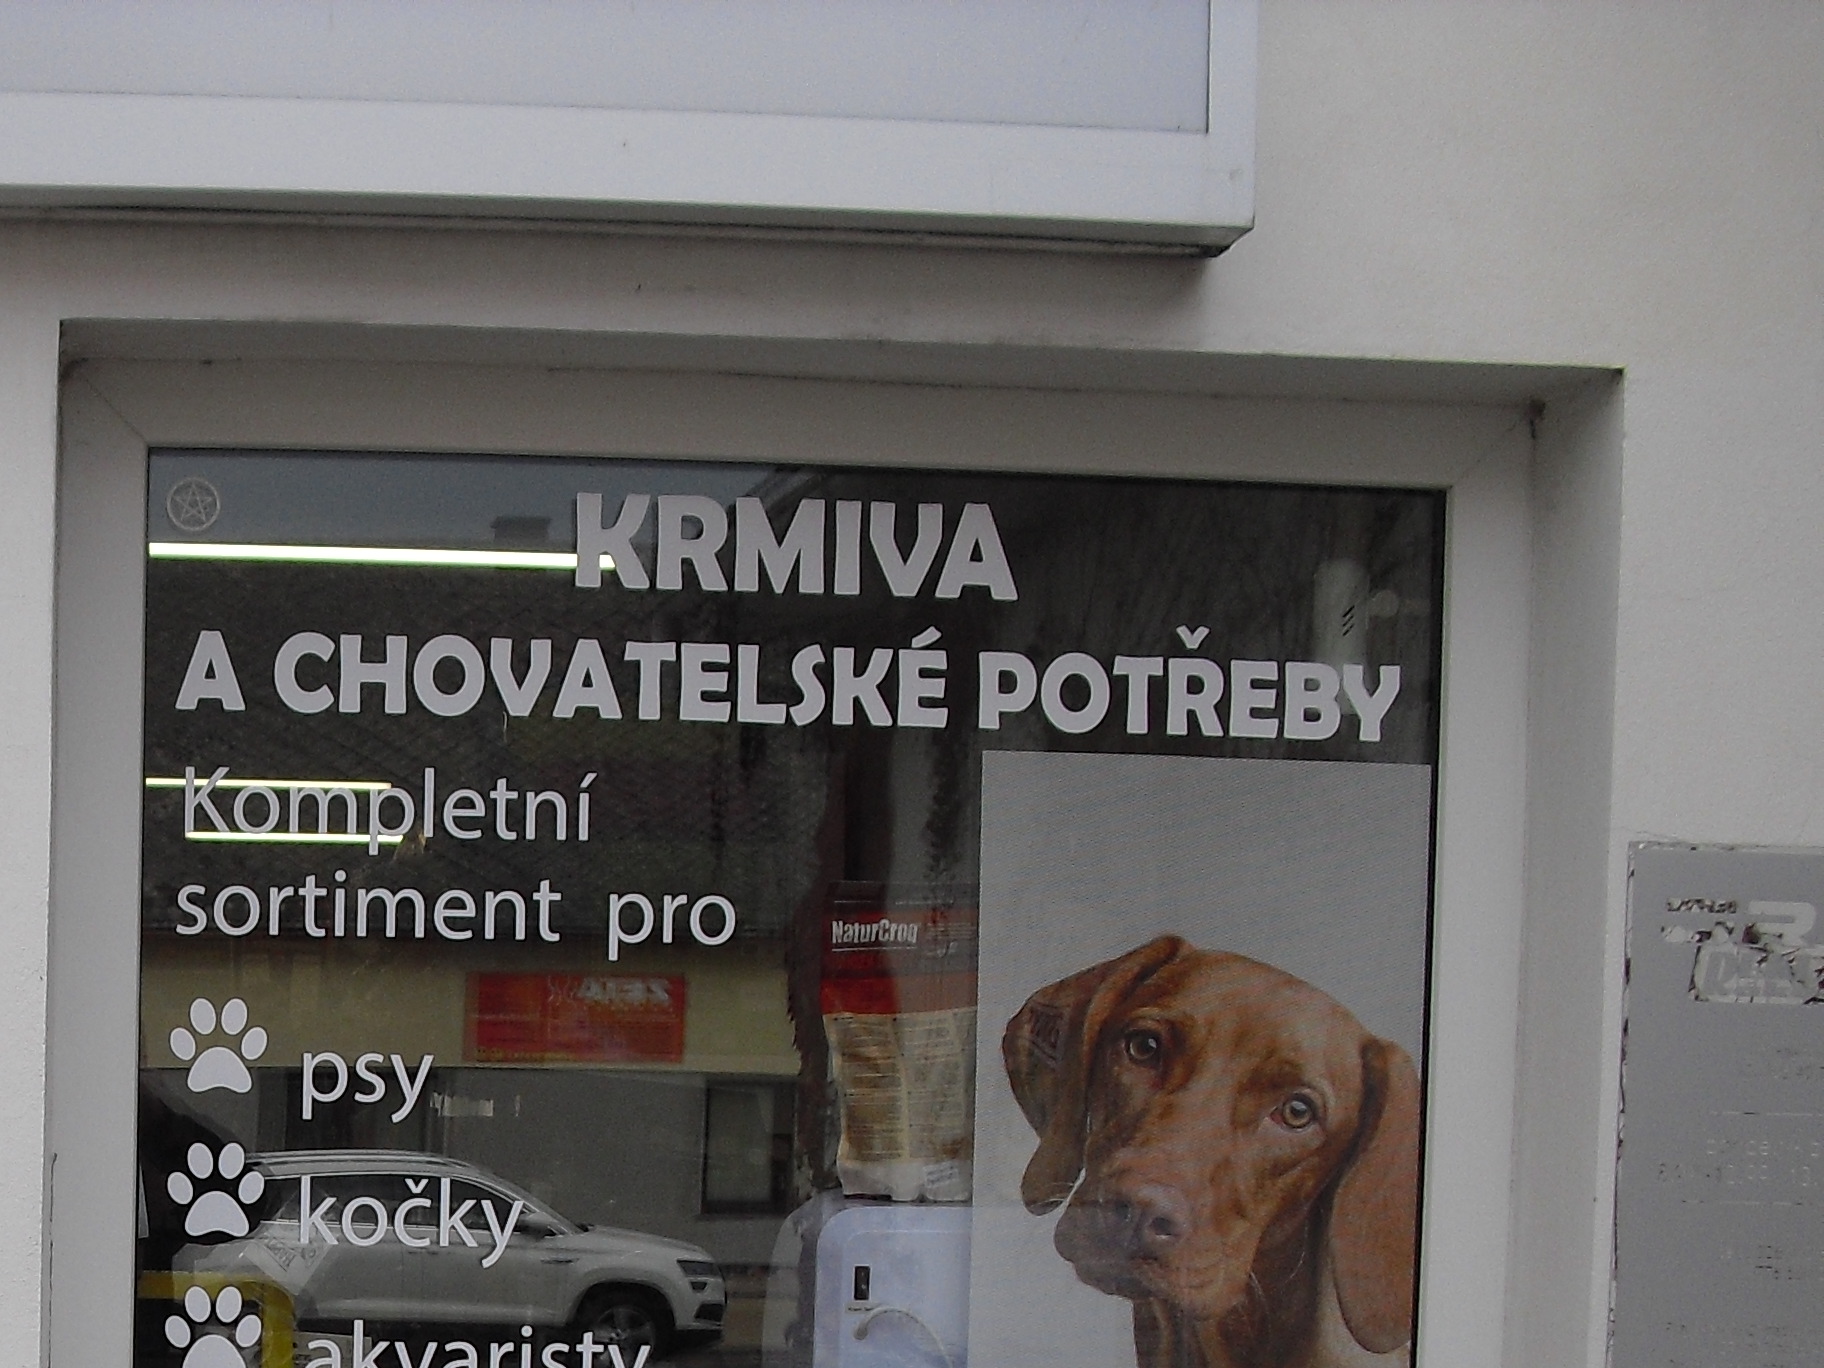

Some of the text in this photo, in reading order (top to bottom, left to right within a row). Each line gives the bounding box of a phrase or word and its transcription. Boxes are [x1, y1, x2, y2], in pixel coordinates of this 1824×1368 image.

[575, 491, 1018, 601] KRMIVA
[176, 627, 1401, 742] A CHOVATELSKÉ POTŘEBY
[183, 767, 596, 856] Kompletní
[176, 870, 736, 961] sortiment pro
[302, 1052, 433, 1122] psy
[299, 1174, 524, 1268] kočky
